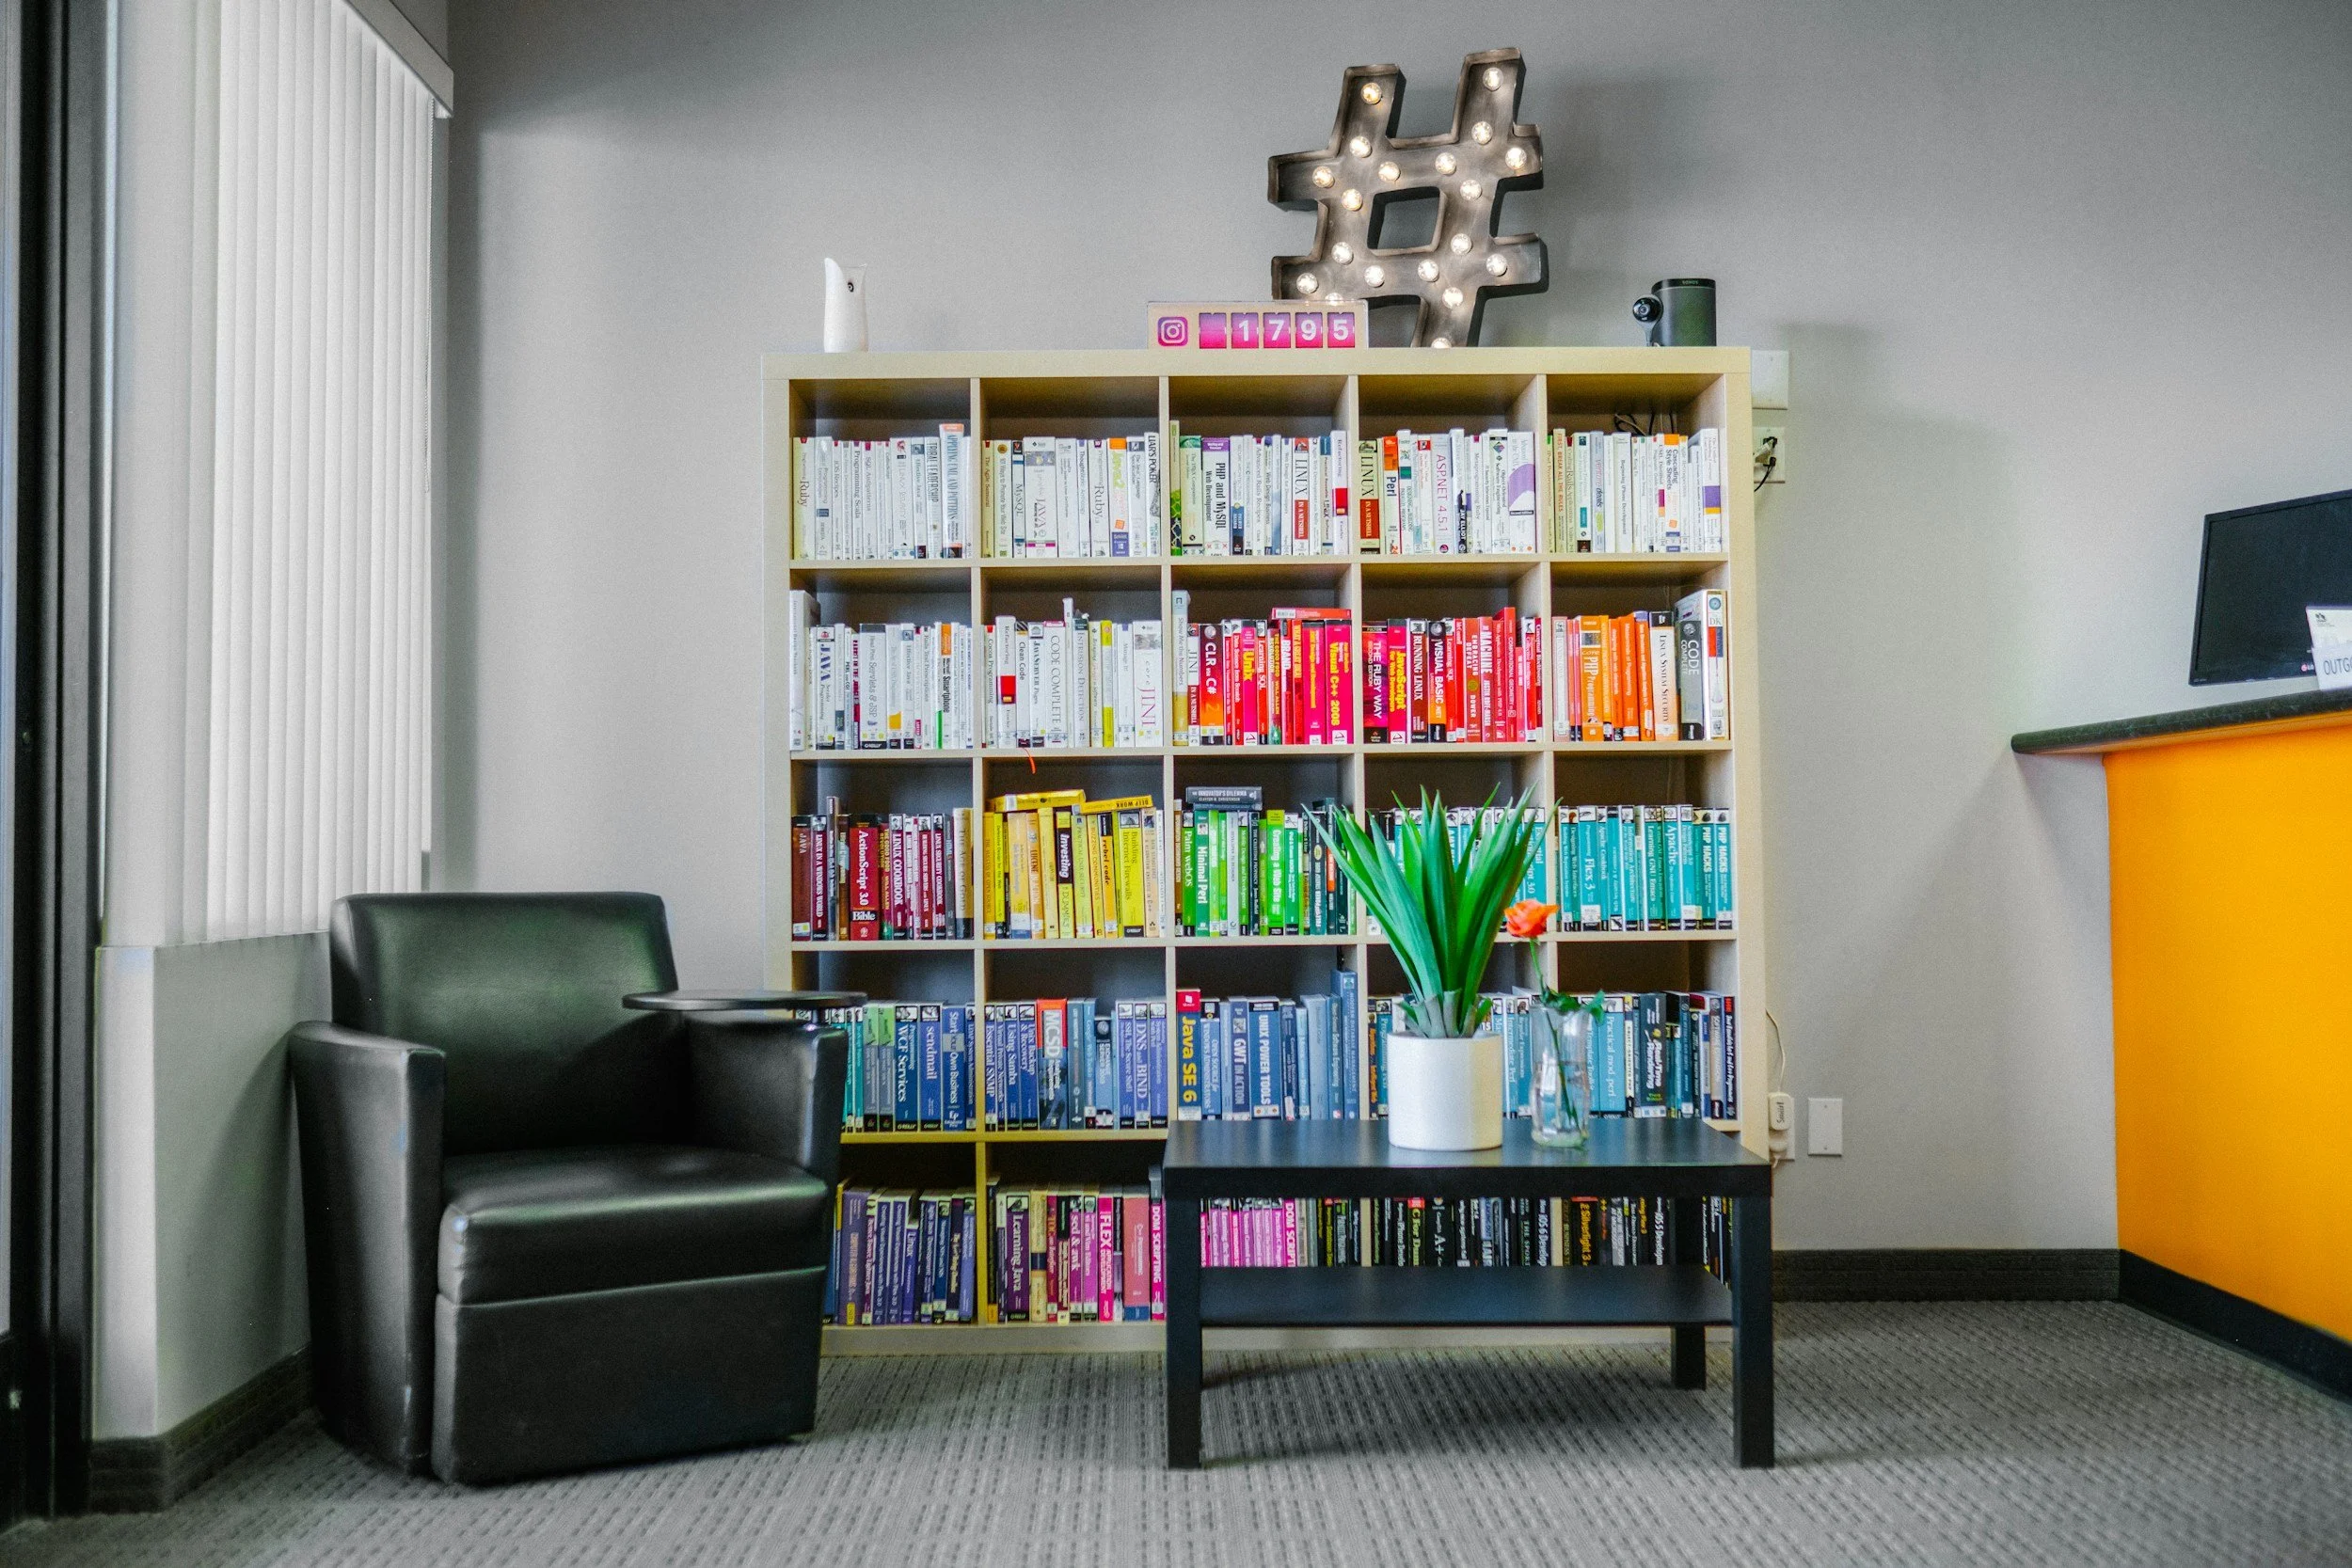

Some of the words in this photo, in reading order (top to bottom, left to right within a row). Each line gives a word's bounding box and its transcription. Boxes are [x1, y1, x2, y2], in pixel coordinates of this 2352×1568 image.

[927, 442, 938, 462] TRIBAL
[1148, 436, 1157, 457] LIAR'S
[928, 464, 939, 503] LEADERSHIP
[1149, 458, 1158, 483] POKER
[1216, 463, 1226, 480] PHP
[1295, 459, 1308, 495] LINUX
[1360, 456, 1375, 497] LINUX
[1436, 454, 1448, 501] ASP.NET
[797, 481, 810, 507] Ruby
[1014, 483, 1024, 517] MySQL
[1216, 483, 1226, 499] and
[1387, 476, 1396, 497] Perl
[1036, 499, 1046, 528] JAVA
[1092, 485, 1104, 518] Ruby
[1204, 484, 1213, 522] Development
[1214, 501, 1226, 530] MySQL
[1438, 505, 1448, 531] 4.5.1
[820, 643, 831, 682] JAVA
[1050, 635, 1061, 665] CODE
[1188, 650, 1198, 673] JINI
[1205, 641, 1216, 666] CLR
[1257, 640, 1265, 673] Learning
[1374, 641, 1382, 662] THE
[1413, 635, 1423, 673] RUNNING
[1434, 641, 1443, 674] VISUAL
[1480, 631, 1493, 674] MACHINE
[1687, 640, 1699, 675] CODE
[1243, 651, 1255, 682] Unix
[1374, 664, 1382, 693] RUBY
[1396, 651, 1406, 710] JavaScript
[1583, 657, 1598, 675] PHP
[942, 675, 951, 713] Smartphone
[1051, 667, 1062, 723] COMPLETE
[1205, 677, 1217, 694] C#
[1258, 674, 1266, 690] SQL
[1413, 674, 1423, 701] LINUX
[1435, 676, 1443, 704] BASIC
[1587, 676, 1597, 716] Programming
[1136, 687, 1156, 727] JINI
[1374, 695, 1382, 720] WAY
[799, 832, 807, 854] JAVA
[892, 833, 902, 859] LINUX
[1183, 831, 1193, 853] Palm
[1270, 830, 1282, 861] Creating
[1647, 825, 1656, 857] Learning
[1664, 825, 1677, 865] Apache
[1702, 827, 1711, 844] PHP
[1718, 827, 1727, 844] PHP
[856, 830, 869, 890] ActionScript
[1059, 833, 1071, 879] Investing
[1102, 839, 1110, 863] rebel
[1197, 846, 1207, 882] Minimal
[1703, 846, 1712, 873] HACKS
[1719, 846, 1727, 873] HACKS
[893, 859, 903, 906] COOKBOOK
[1184, 855, 1193, 887] webOS
[1273, 869, 1281, 887] Web
[1584, 858, 1596, 881] Flex
[859, 892, 869, 906] 3.0
[1197, 884, 1208, 904] Perl
[1273, 887, 1282, 902] Site
[1584, 882, 1596, 891] 3
[948, 1011, 959, 1034] Start
[1045, 1011, 1061, 1057] MCSD
[1136, 1023, 1147, 1051] DNS
[1259, 1015, 1269, 1037] UNIX
[1606, 1016, 1614, 1053] Practical
[898, 1024, 909, 1053] WCF
[985, 1023, 995, 1066] Essential
[1006, 1024, 1017, 1053] Using
[1182, 1016, 1197, 1059] Java
[1233, 1037, 1247, 1065] GWT
[926, 1025, 938, 1080] sendmail
[949, 1052, 959, 1072] Own
[1259, 1039, 1270, 1072] POWER
[1646, 1042, 1655, 1089] Rendering
[898, 1054, 908, 1102] Services
[986, 1067, 995, 1098] SNMP
[1009, 1053, 1018, 1085] Samba
[1136, 1064, 1148, 1100] BIND
[1183, 1063, 1197, 1086] SE
[1234, 1065, 1244, 1074] IN
[949, 1072, 960, 1104] Business
[1183, 1089, 1198, 1102] 6
[1234, 1075, 1245, 1105] ACTION
[1260, 1075, 1271, 1105] TOOLS
[1152, 1205, 1161, 1231] DOM
[1285, 1203, 1295, 1228] DOM
[1412, 1209, 1421, 1218] C
[906, 1231, 916, 1258] Linux
[1010, 1214, 1024, 1265] Learning
[1100, 1214, 1112, 1248] FLEX
[1434, 1234, 1446, 1255] A+
[1580, 1210, 1592, 1253] Silverlight
[1152, 1232, 1161, 1283] SCRIPTING
[1011, 1267, 1024, 1291] Java
